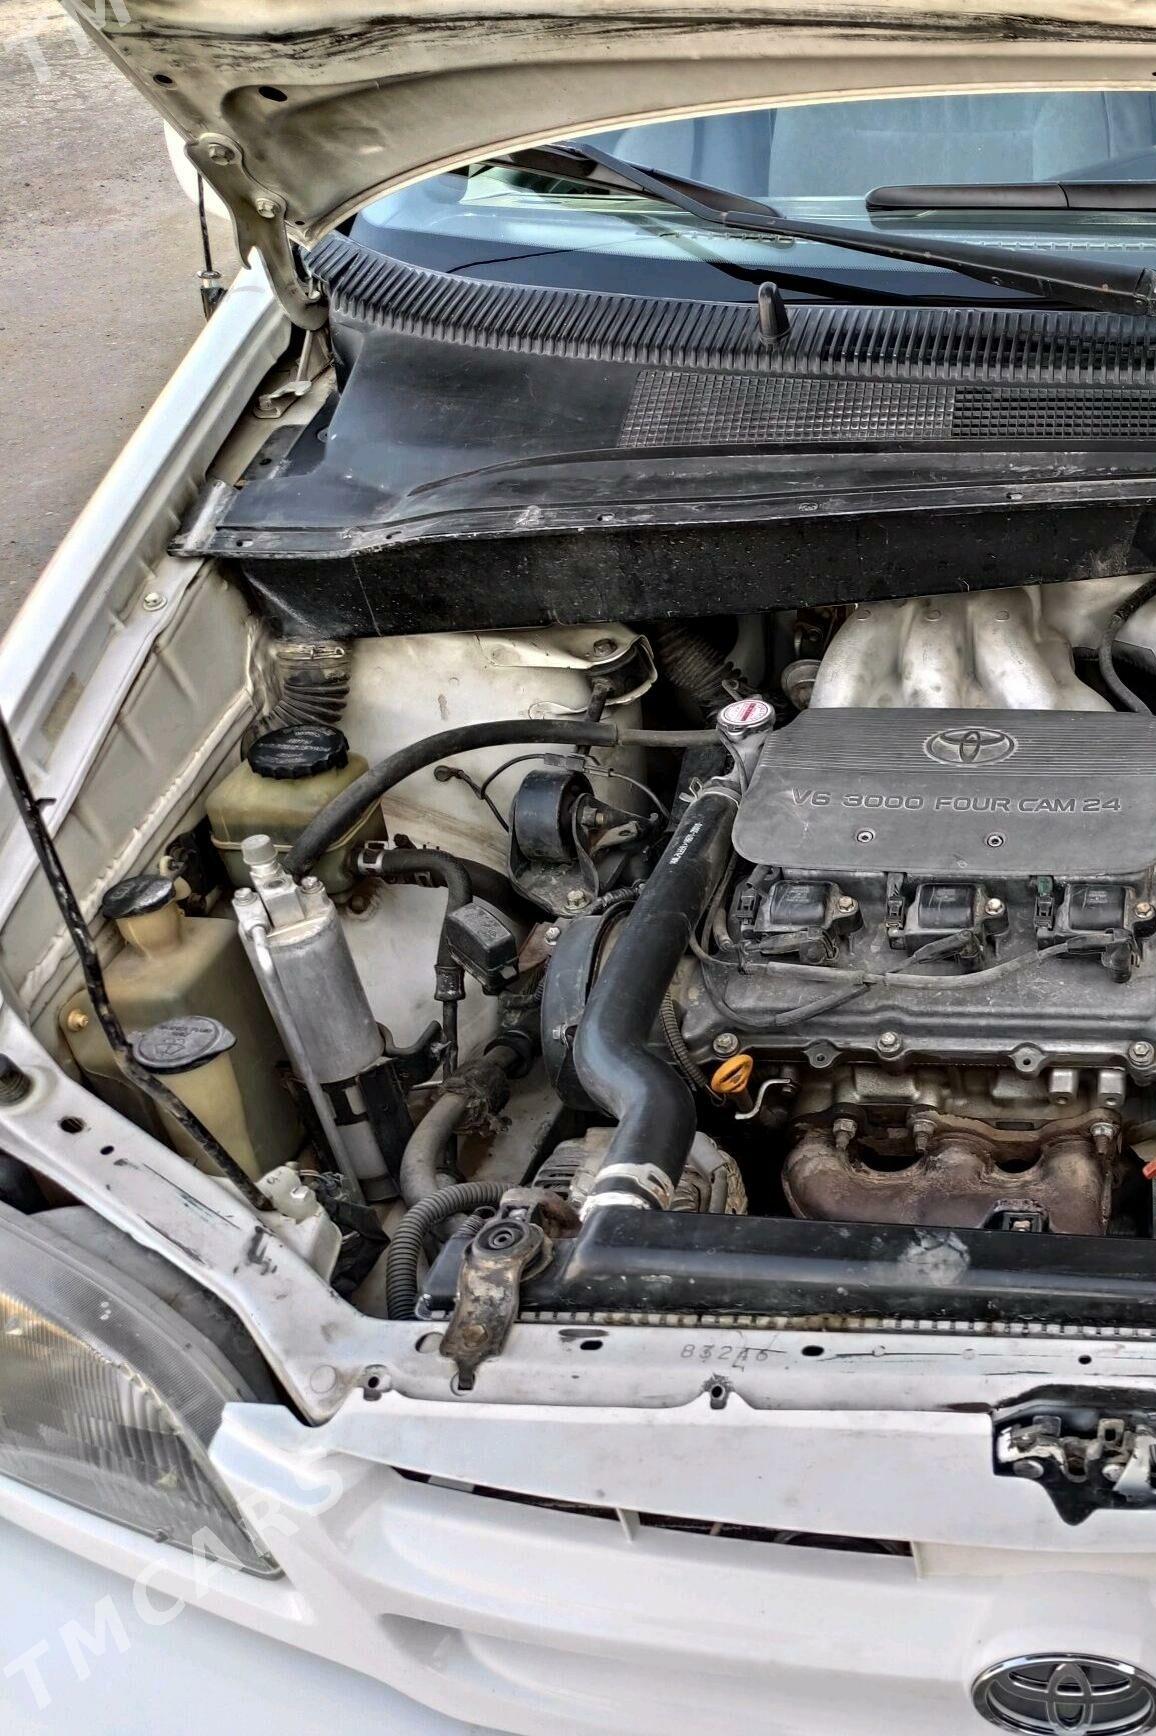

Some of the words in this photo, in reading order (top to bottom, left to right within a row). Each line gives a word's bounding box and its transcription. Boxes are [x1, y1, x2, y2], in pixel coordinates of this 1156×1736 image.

[791, 787, 831, 806] V6
[842, 793, 924, 810] 3000
[934, 795, 1012, 812] FOUR
[1017, 797, 1076, 812] CAM
[1081, 797, 1121, 812] 24
